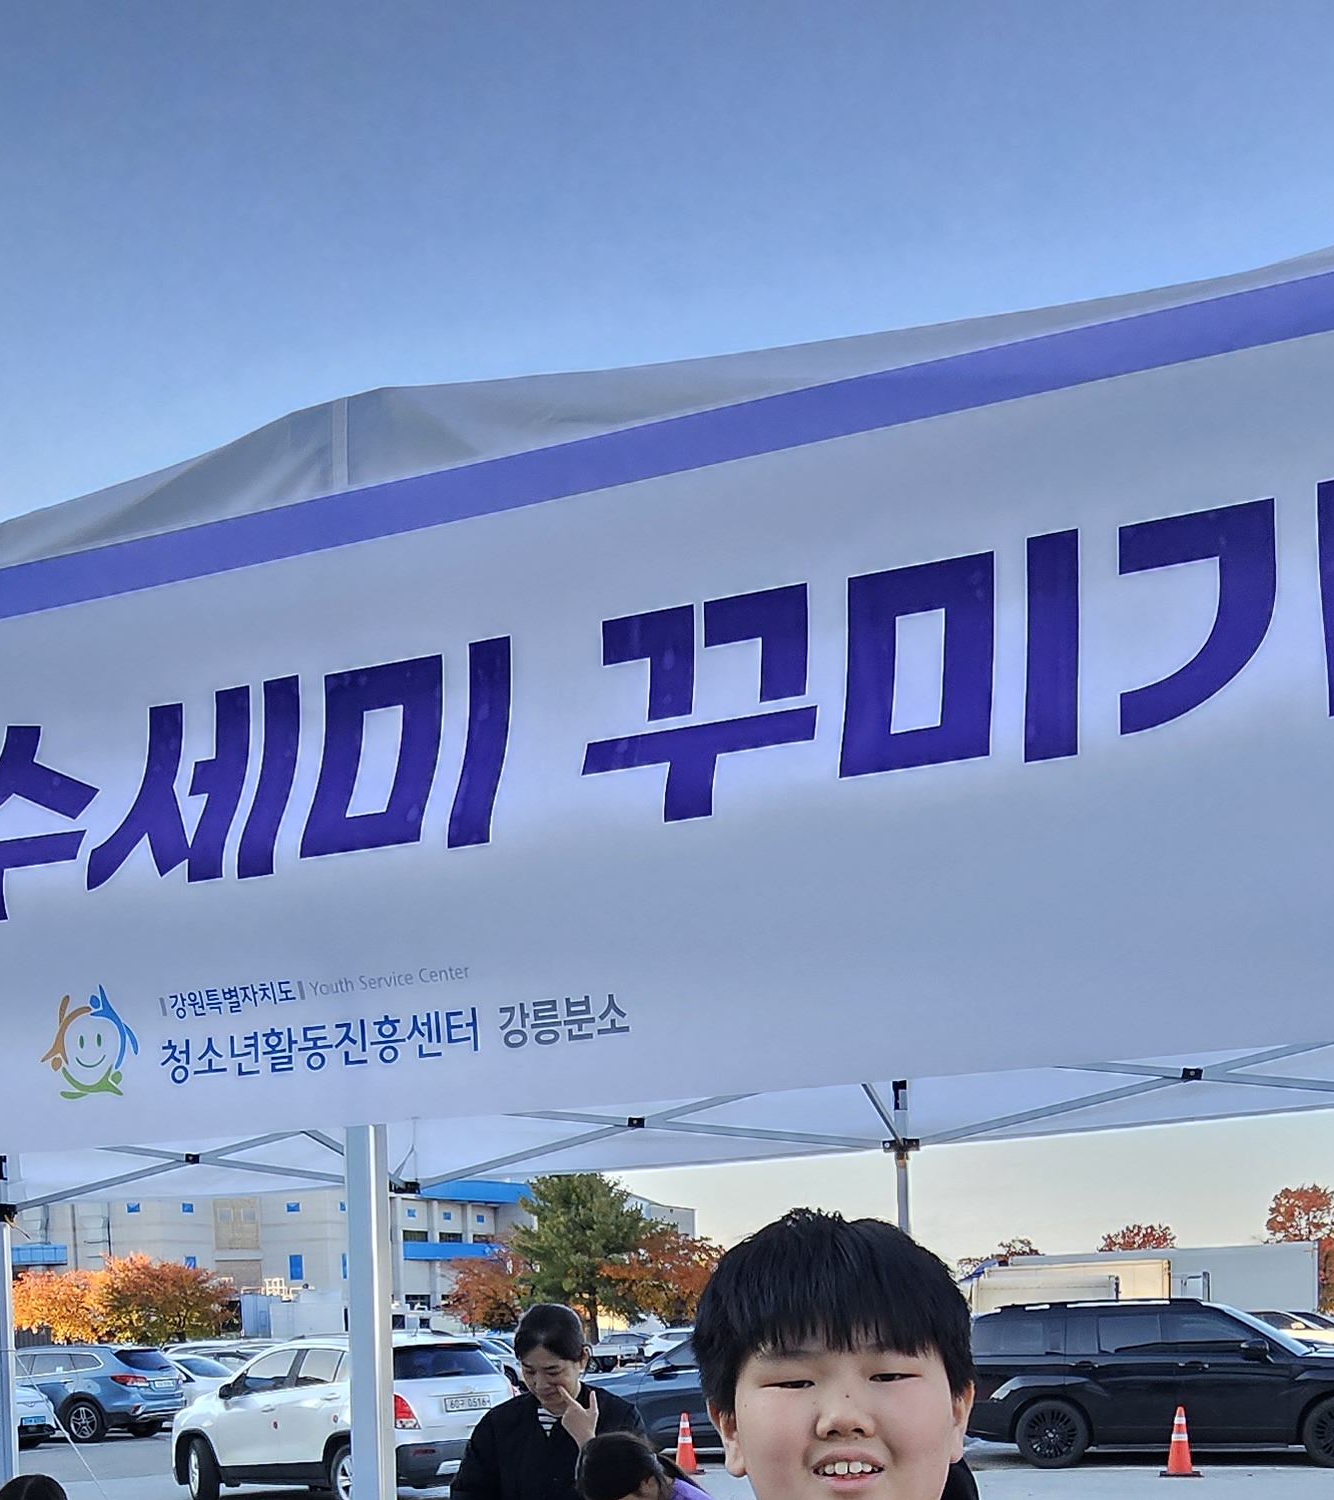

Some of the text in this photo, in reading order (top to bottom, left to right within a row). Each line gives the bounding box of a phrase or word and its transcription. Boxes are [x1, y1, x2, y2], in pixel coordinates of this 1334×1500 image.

[168, 980, 297, 1019] 강원특별자치도
[308, 966, 470, 996] Youth Service Center
[159, 993, 632, 1085] 청소년활동진흥센터 강릉분소
